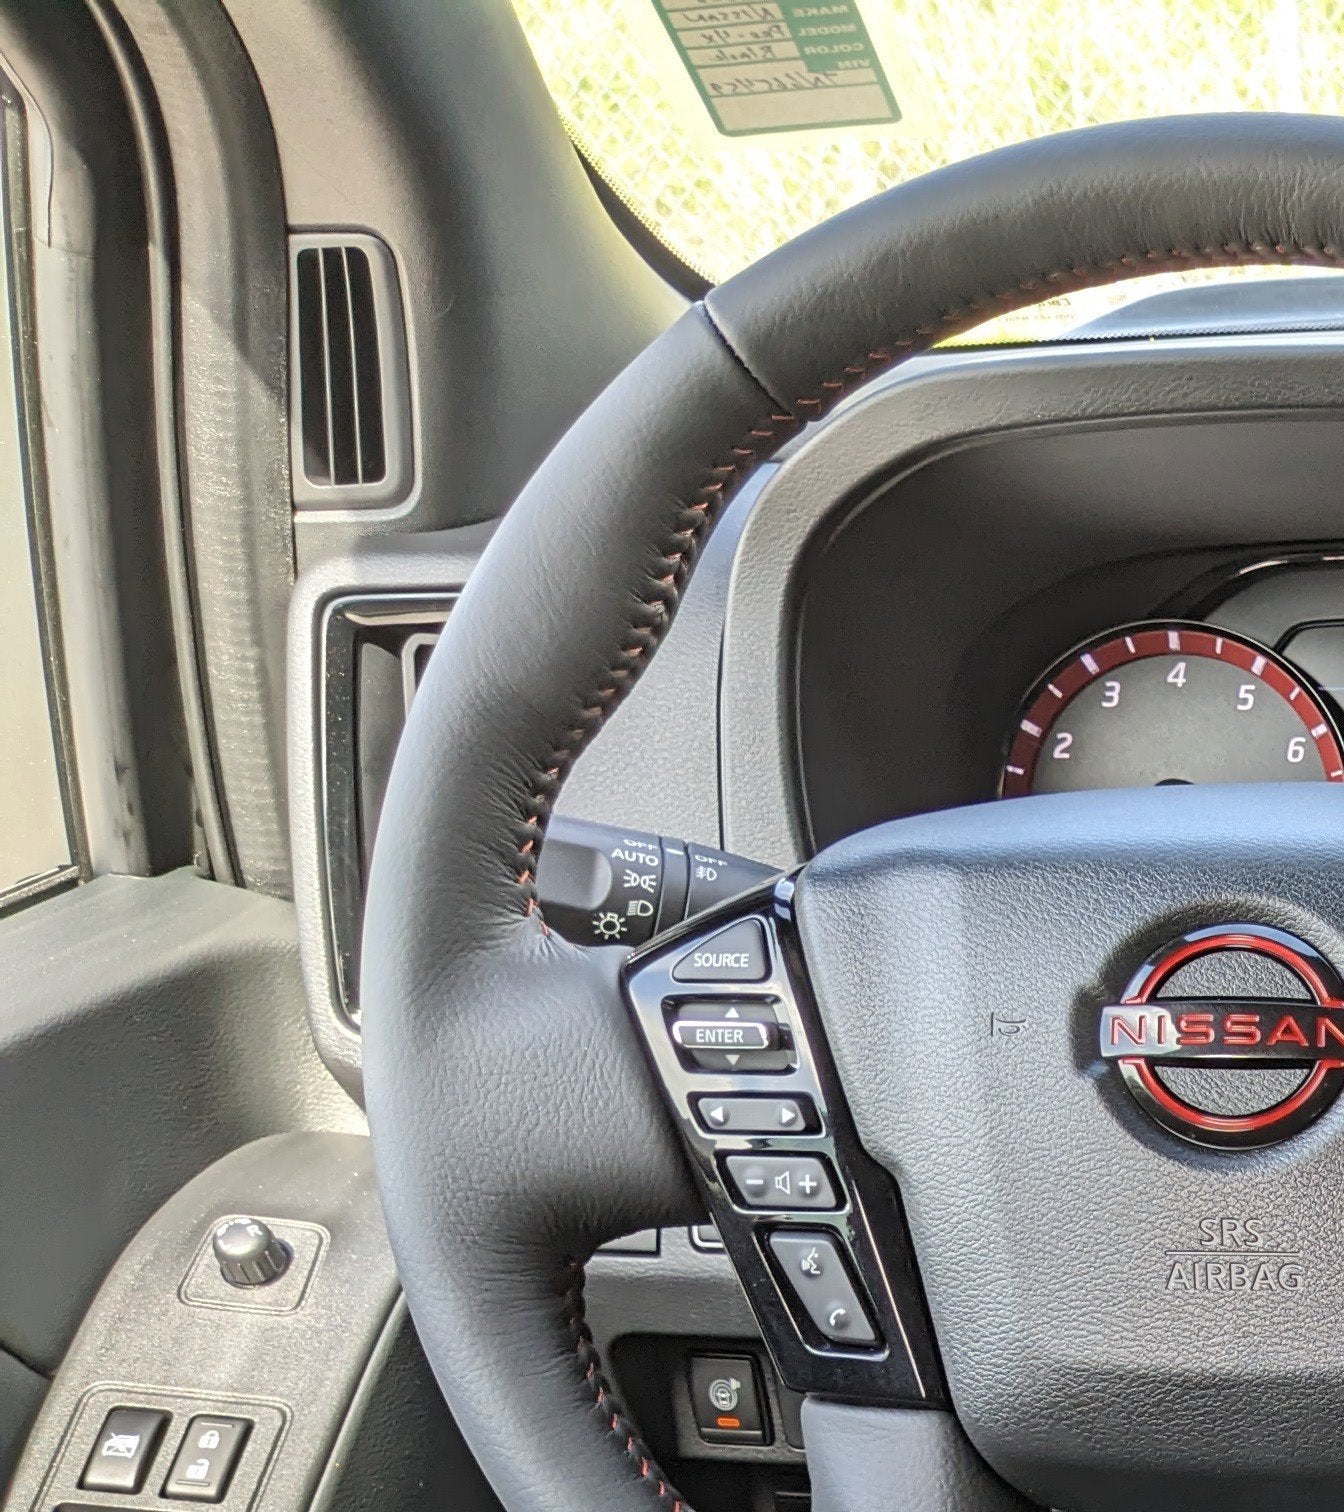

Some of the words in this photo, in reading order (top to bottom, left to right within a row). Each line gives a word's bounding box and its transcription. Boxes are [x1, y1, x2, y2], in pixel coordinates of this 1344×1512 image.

[1166, 662, 1187, 688] 4
[1101, 682, 1121, 708] 3
[1236, 684, 1256, 711] 5
[1052, 732, 1073, 760] 2
[1286, 736, 1306, 763] 6
[611, 848, 659, 867] AUTO
[694, 854, 728, 867] OFF
[693, 952, 750, 969] SOURCE
[695, 1028, 745, 1044] ENTER
[1199, 1217, 1264, 1248] SRS
[1165, 1261, 1302, 1292] AIRBAG
